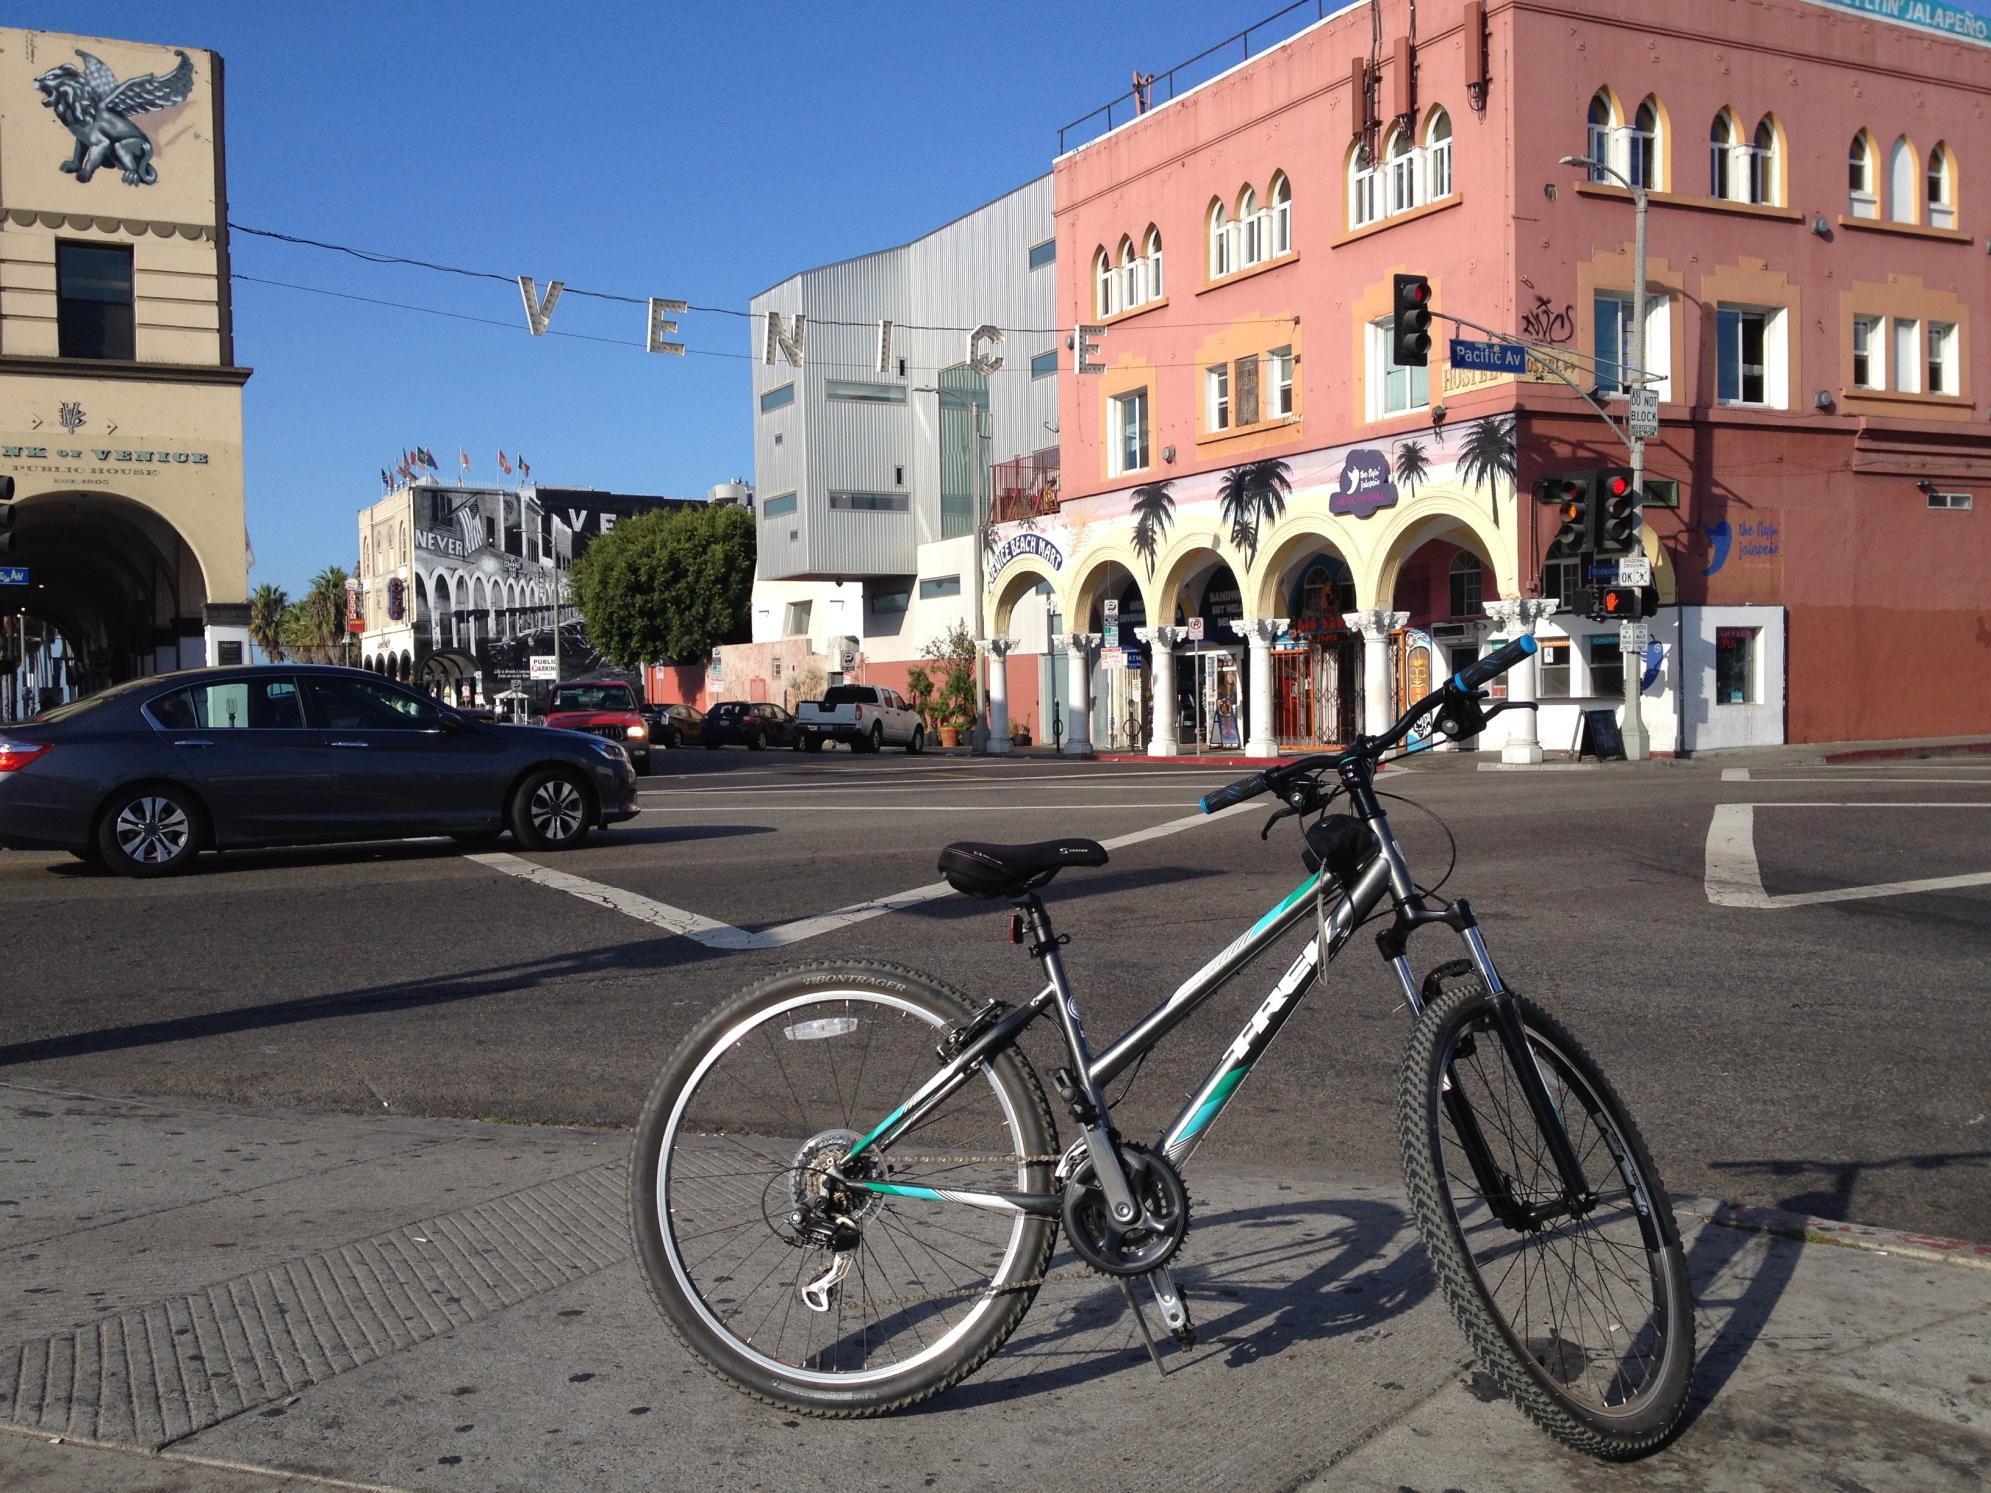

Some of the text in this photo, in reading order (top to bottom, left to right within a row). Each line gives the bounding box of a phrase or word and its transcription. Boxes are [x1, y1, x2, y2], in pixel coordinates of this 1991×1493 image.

[1904, 2, 1987, 38] JALAPEÑO
[517, 275, 1108, 375] VENICE
[1456, 346, 1502, 365] Pacific
[1505, 350, 1521, 366] Av
[1631, 396, 1657, 407] DO NOT
[1631, 411, 1657, 422] BLOCK
[91, 448, 210, 465] VENICE
[12, 464, 160, 477] PUBLIC HOUSE
[414, 528, 464, 557] NEVER
[989, 535, 1061, 583] VENICE BEACH MART
[1621, 572, 1633, 583] OK
[816, 974, 907, 993] BONTRAGER
